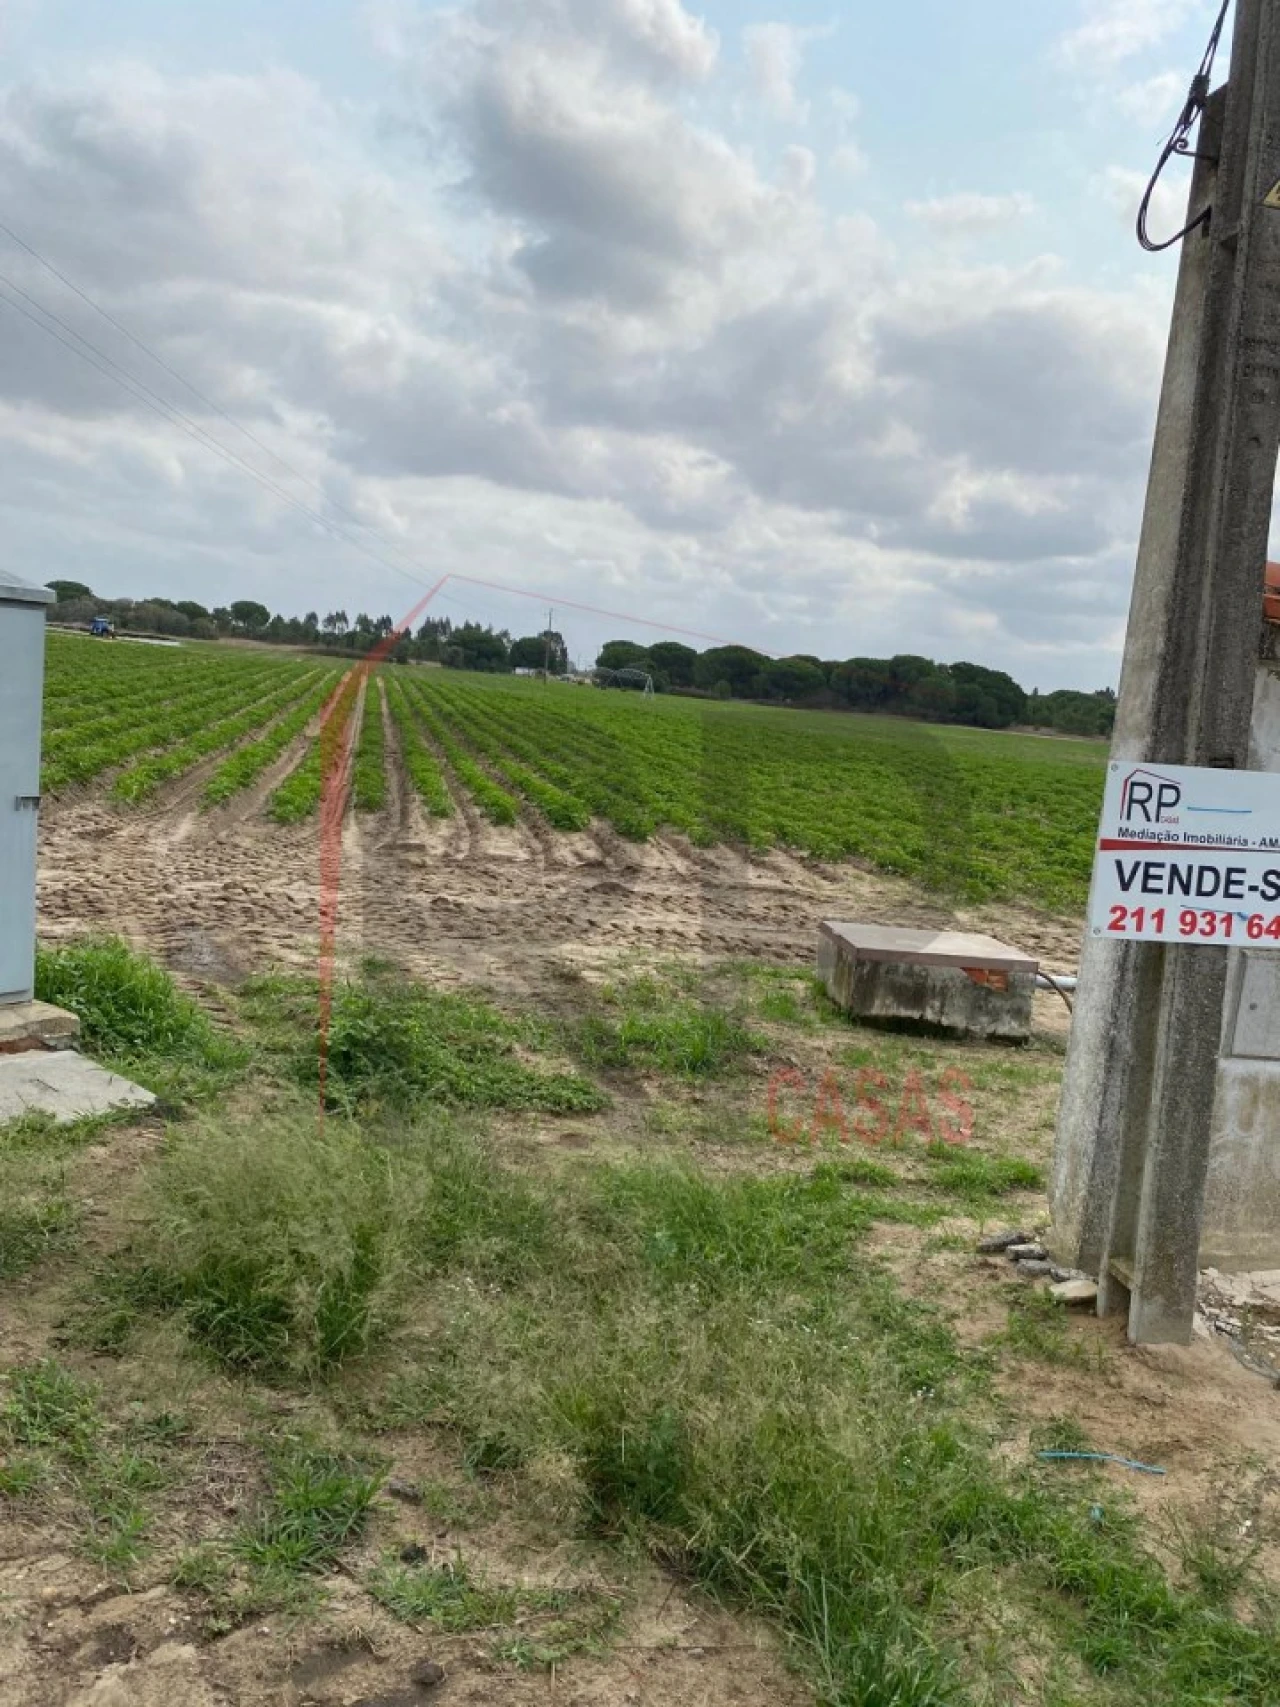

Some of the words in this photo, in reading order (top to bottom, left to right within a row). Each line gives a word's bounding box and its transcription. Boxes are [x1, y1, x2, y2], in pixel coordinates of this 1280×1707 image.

[1126, 780, 1181, 824] RP
[1117, 826, 1180, 842] Mediação
[1107, 904, 1165, 934] 211
[1179, 909, 1233, 938] 931
[1246, 913, 1280, 940] 64
